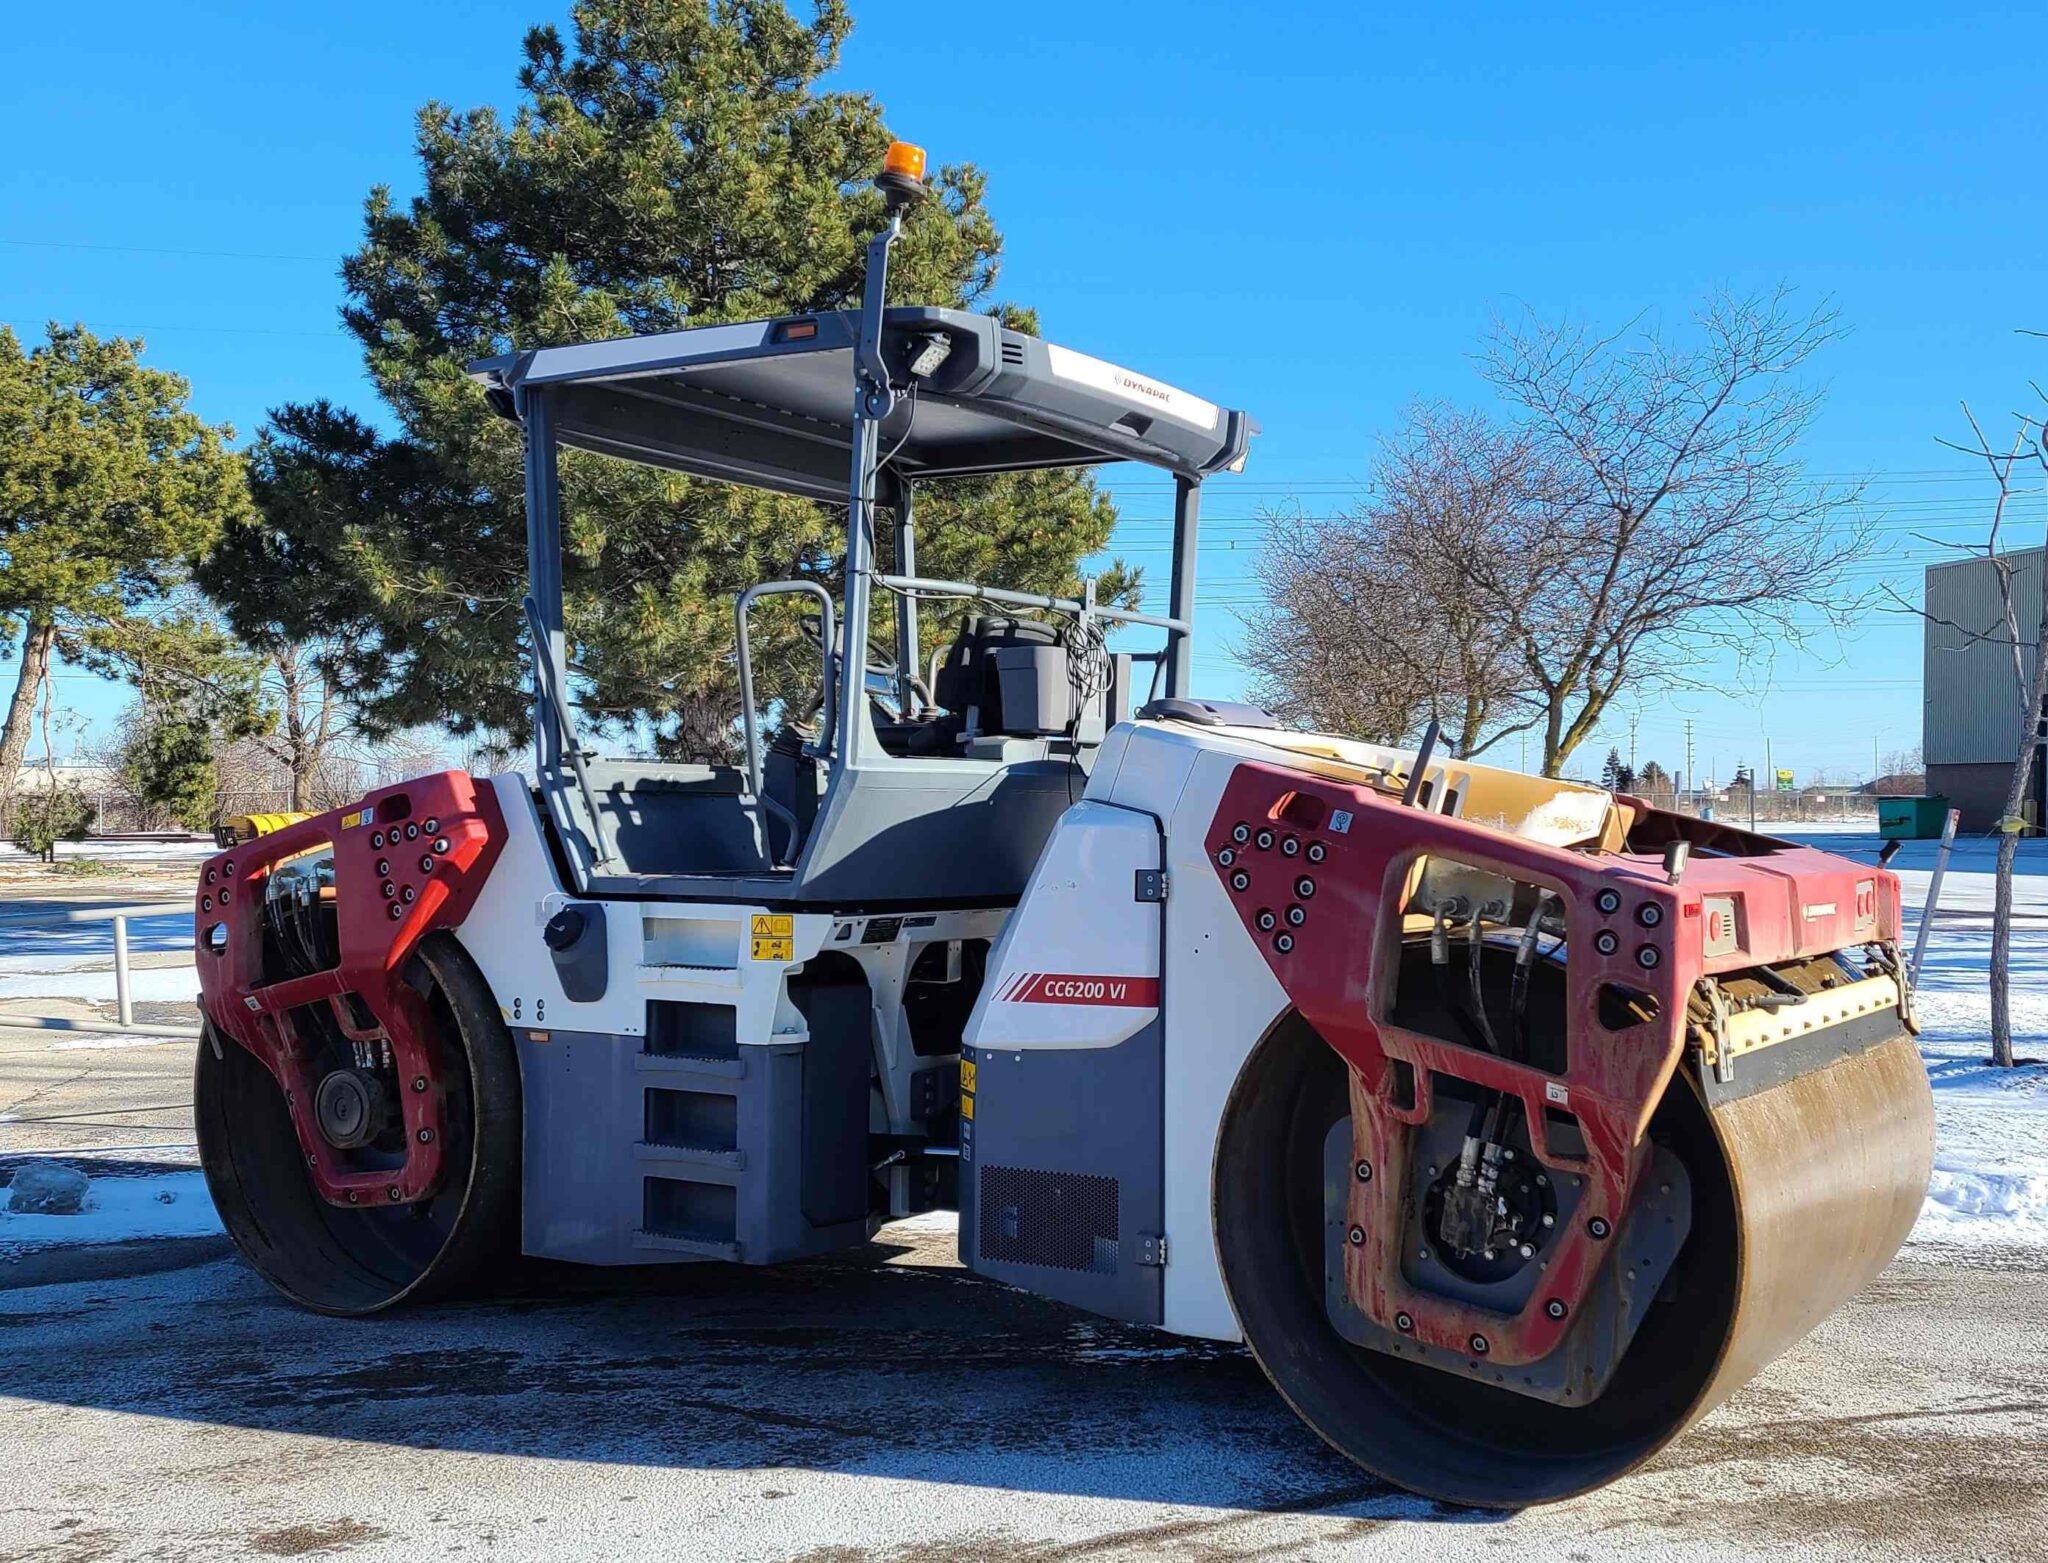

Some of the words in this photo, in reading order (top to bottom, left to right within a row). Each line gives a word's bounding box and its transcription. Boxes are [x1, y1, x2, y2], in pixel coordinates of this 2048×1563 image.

[1123, 378, 1170, 402] DYNAPAC
[1044, 980, 1105, 999] CC6200
[1109, 983, 1127, 1000] VI
